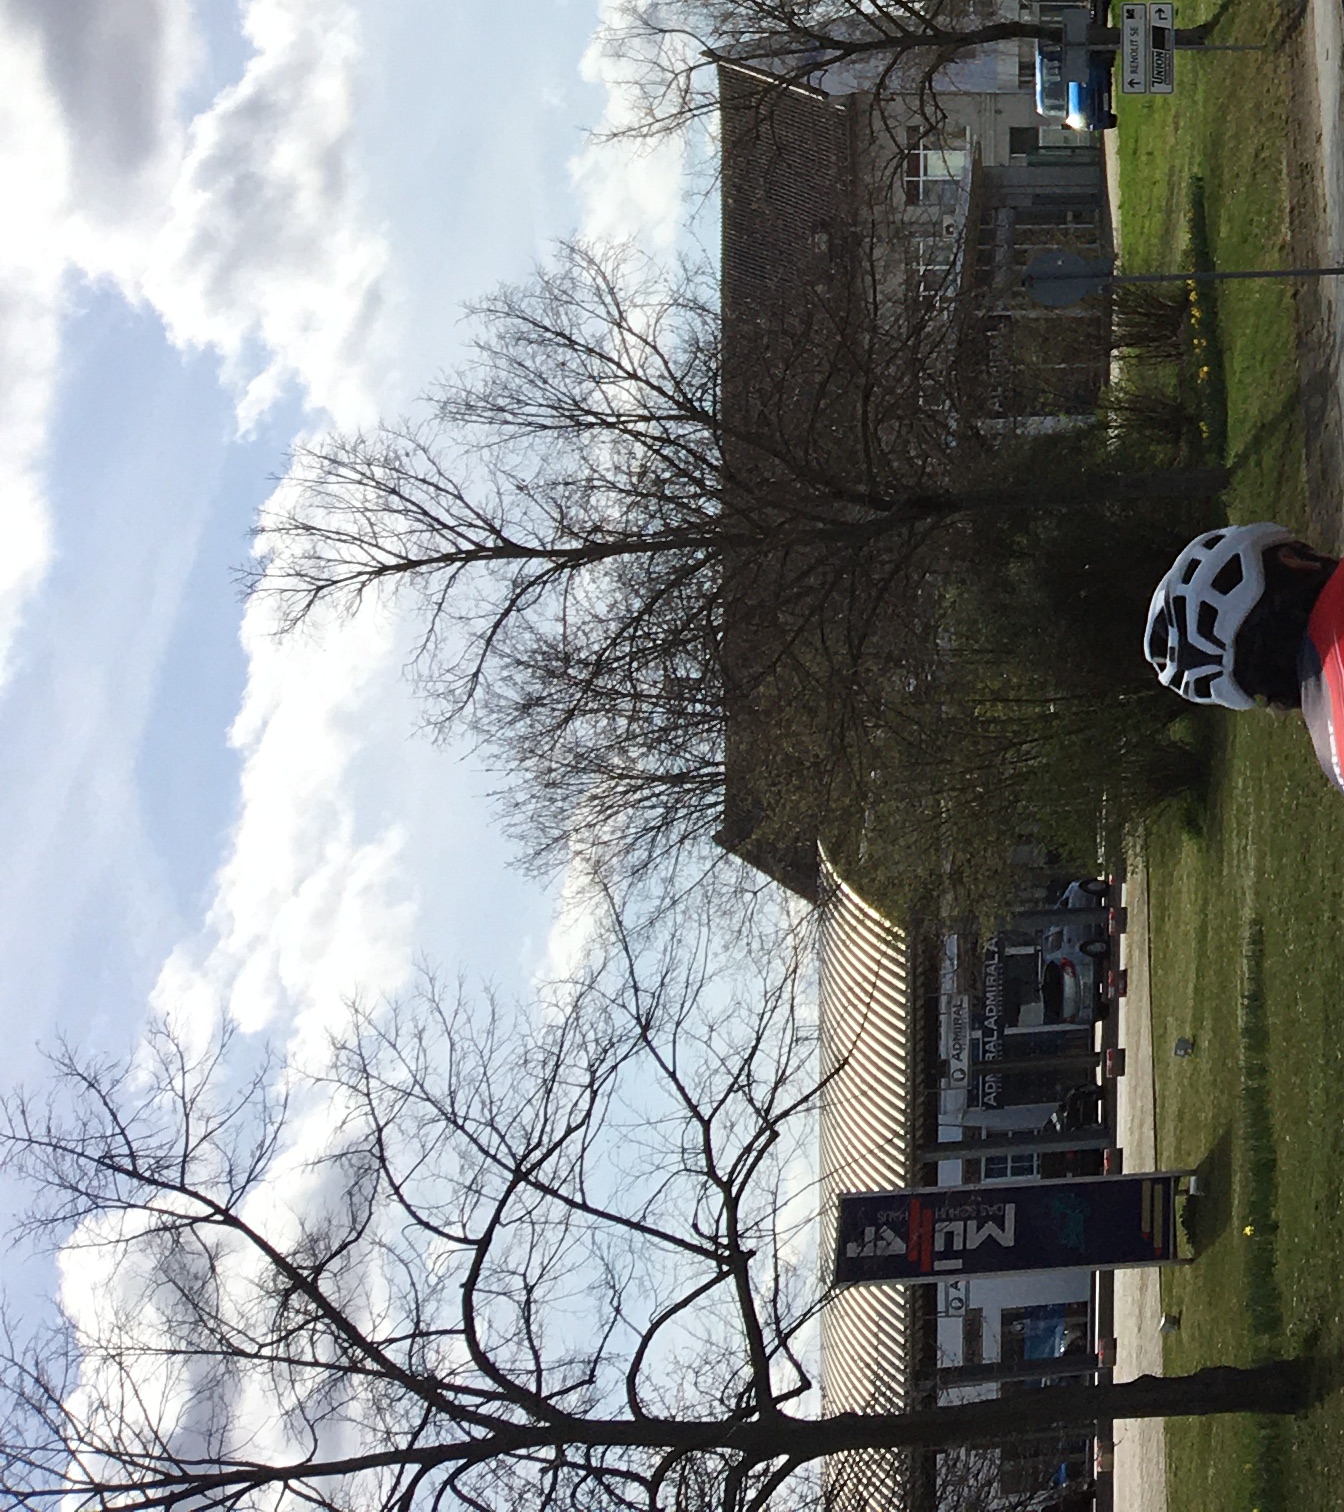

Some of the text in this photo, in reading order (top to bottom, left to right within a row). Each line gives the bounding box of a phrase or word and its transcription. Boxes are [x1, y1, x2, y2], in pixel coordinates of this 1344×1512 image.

[1130, 26, 1138, 74] RENOLIT SE
[1152, 50, 1164, 87] UNION
[984, 954, 998, 1030] ADMIRAL
[952, 999, 963, 1062] ADMIRAL
[984, 1030, 997, 1106] ADMRAL
[878, 1210, 909, 1221] HAUS
[980, 1203, 1004, 1216] DAS
